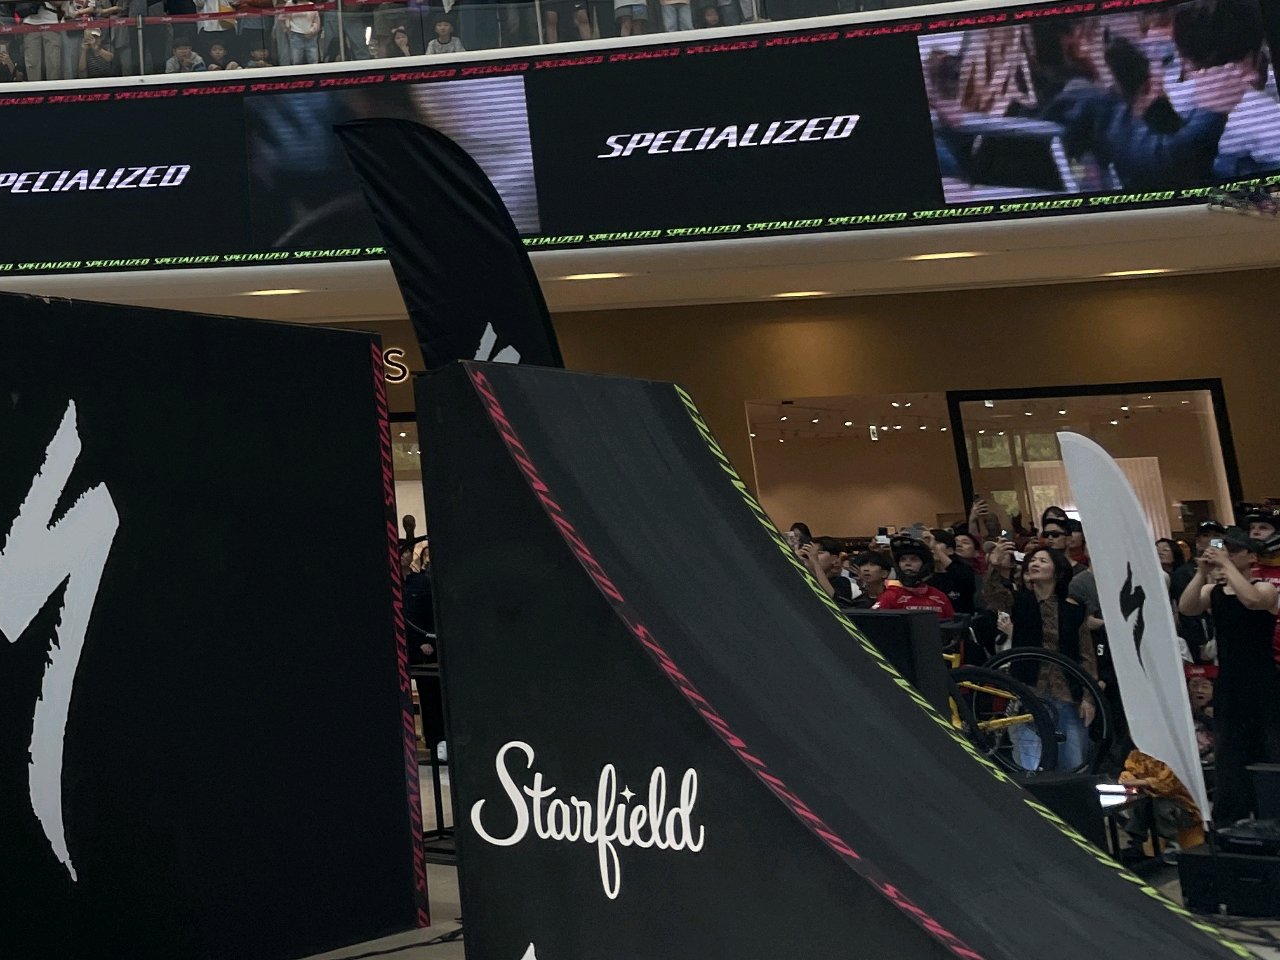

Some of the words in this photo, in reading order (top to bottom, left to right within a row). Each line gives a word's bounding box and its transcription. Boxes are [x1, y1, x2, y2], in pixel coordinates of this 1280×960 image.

[596, 113, 861, 159] SPECIALIZED
[16, 260, 81, 270] SPECIALIZED
[85, 258, 150, 268] SPECIALIZED
[153, 255, 219, 265] SPECIALIZED
[222, 251, 290, 262] SPECIALIZED
[293, 247, 361, 259] SPECIALIZED
[587, 230, 661, 242] SPECIALIZED
[666, 224, 741, 237] SPECIALIZED
[745, 218, 822, 231] SPECIALIZED
[827, 212, 908, 225] SPECIALIZED
[911, 205, 994, 219] SPECIALIZED
[998, 198, 1082, 213] SPECIALIZED
[1087, 191, 1175, 206] SPECIALIZED
[470, 740, 705, 900] Starfield
